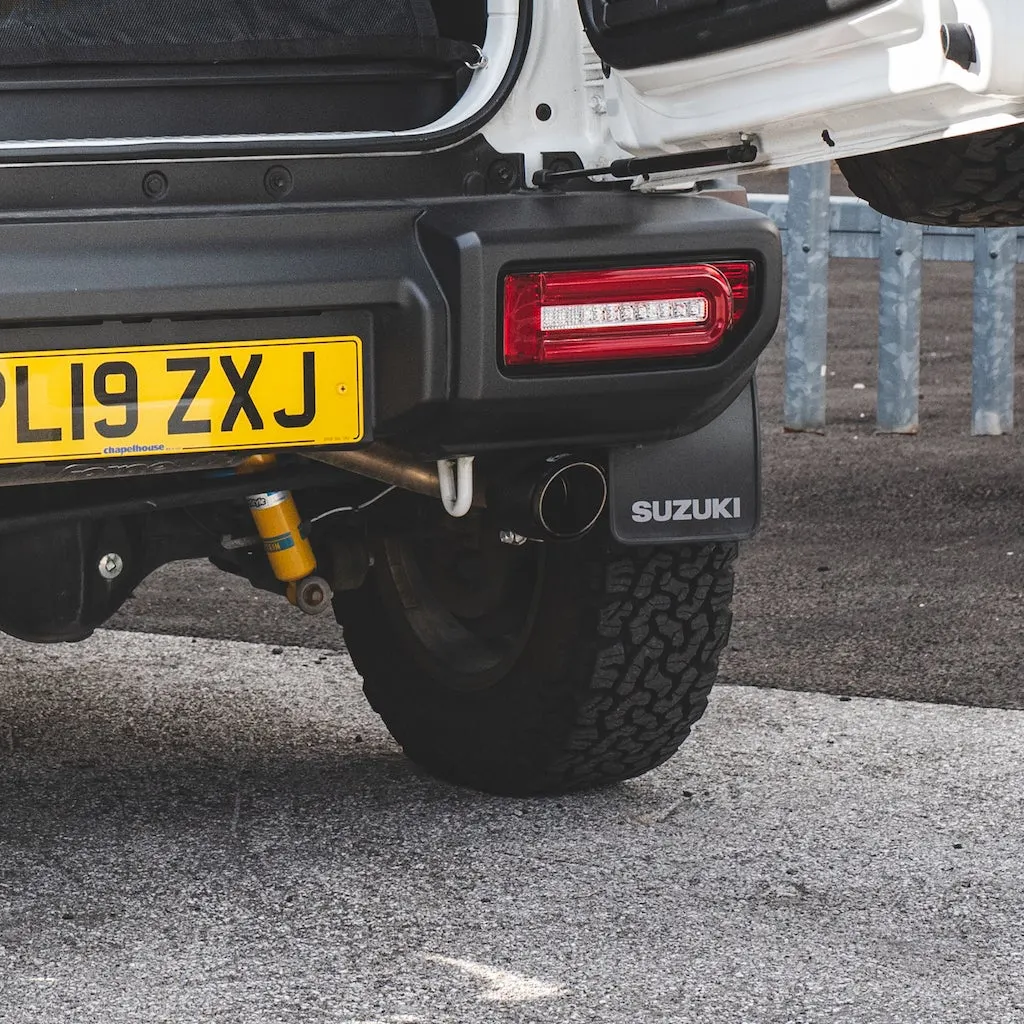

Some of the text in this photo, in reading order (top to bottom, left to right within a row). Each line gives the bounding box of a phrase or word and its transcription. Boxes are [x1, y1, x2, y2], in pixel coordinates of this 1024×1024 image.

[166, 351, 317, 436] ZXJ
[102, 443, 165, 455] chapelhouse
[631, 497, 741, 523] SUZUKI
